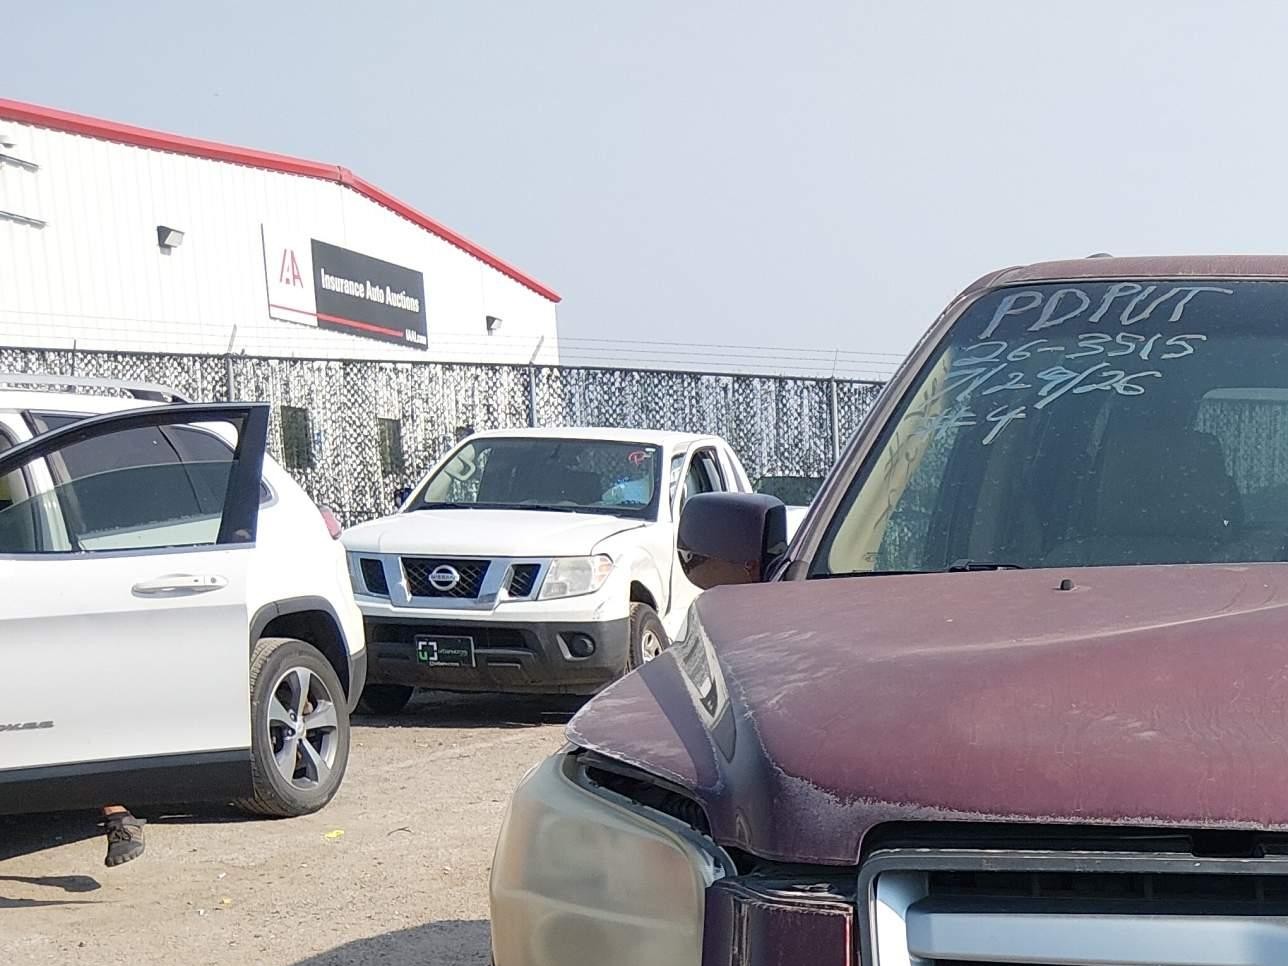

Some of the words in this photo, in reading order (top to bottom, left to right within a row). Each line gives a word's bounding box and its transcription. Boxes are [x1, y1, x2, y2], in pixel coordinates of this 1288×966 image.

[320, 267, 365, 299] Insurance
[365, 280, 385, 304] Auto
[385, 285, 420, 313] Auctions
[952, 333, 1207, 367] 26-3515
